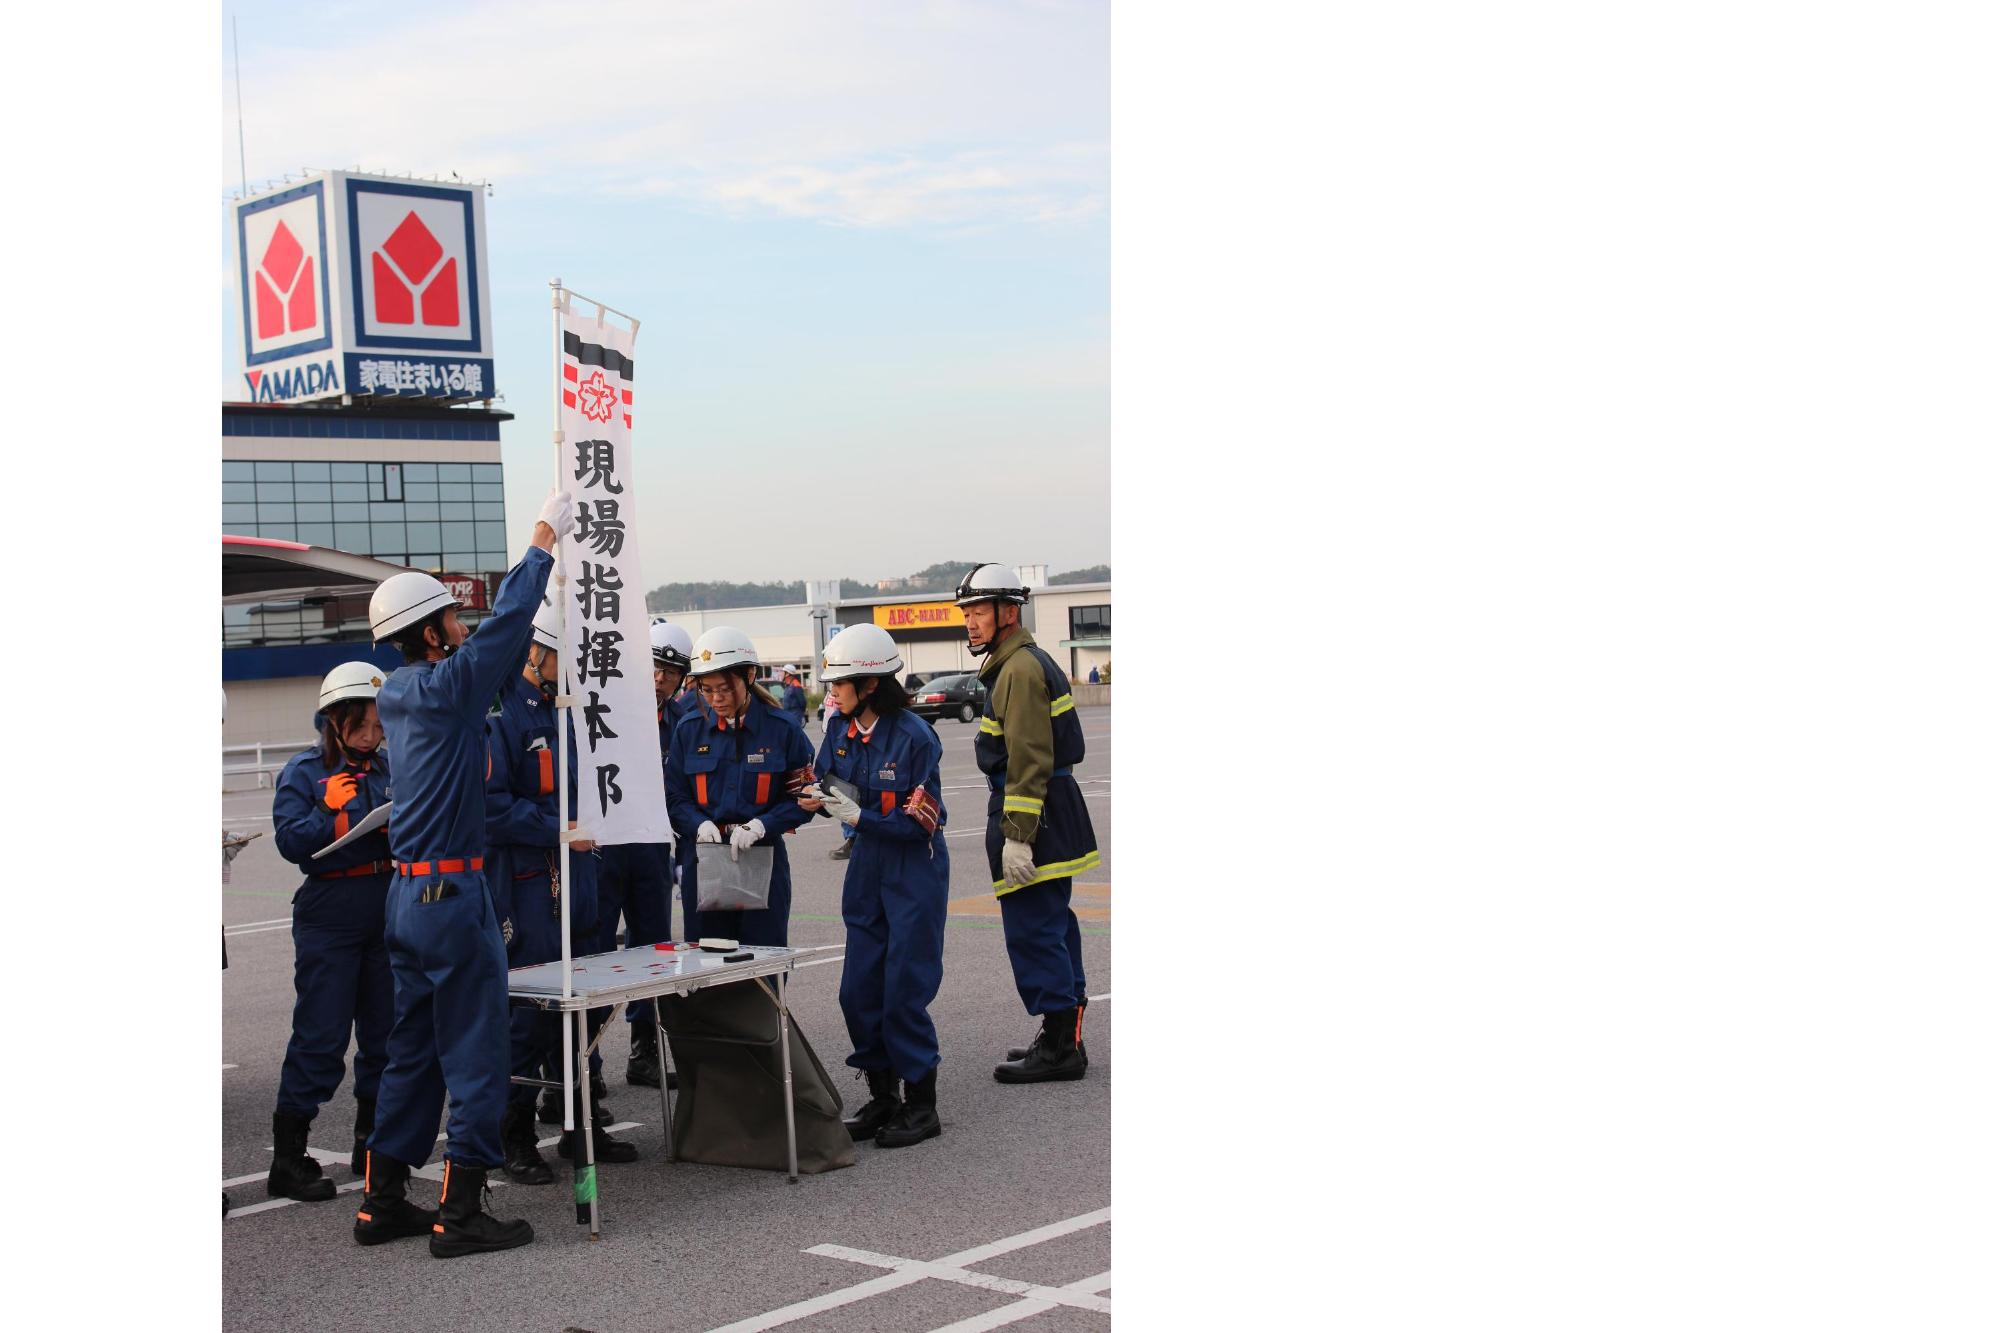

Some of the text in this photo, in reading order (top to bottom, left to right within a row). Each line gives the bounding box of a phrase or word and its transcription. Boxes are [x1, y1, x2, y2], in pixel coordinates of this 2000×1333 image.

[244, 360, 339, 403] YAMADA
[359, 360, 482, 393] 家電住まいる館
[888, 608, 951, 625] ABC-MART
